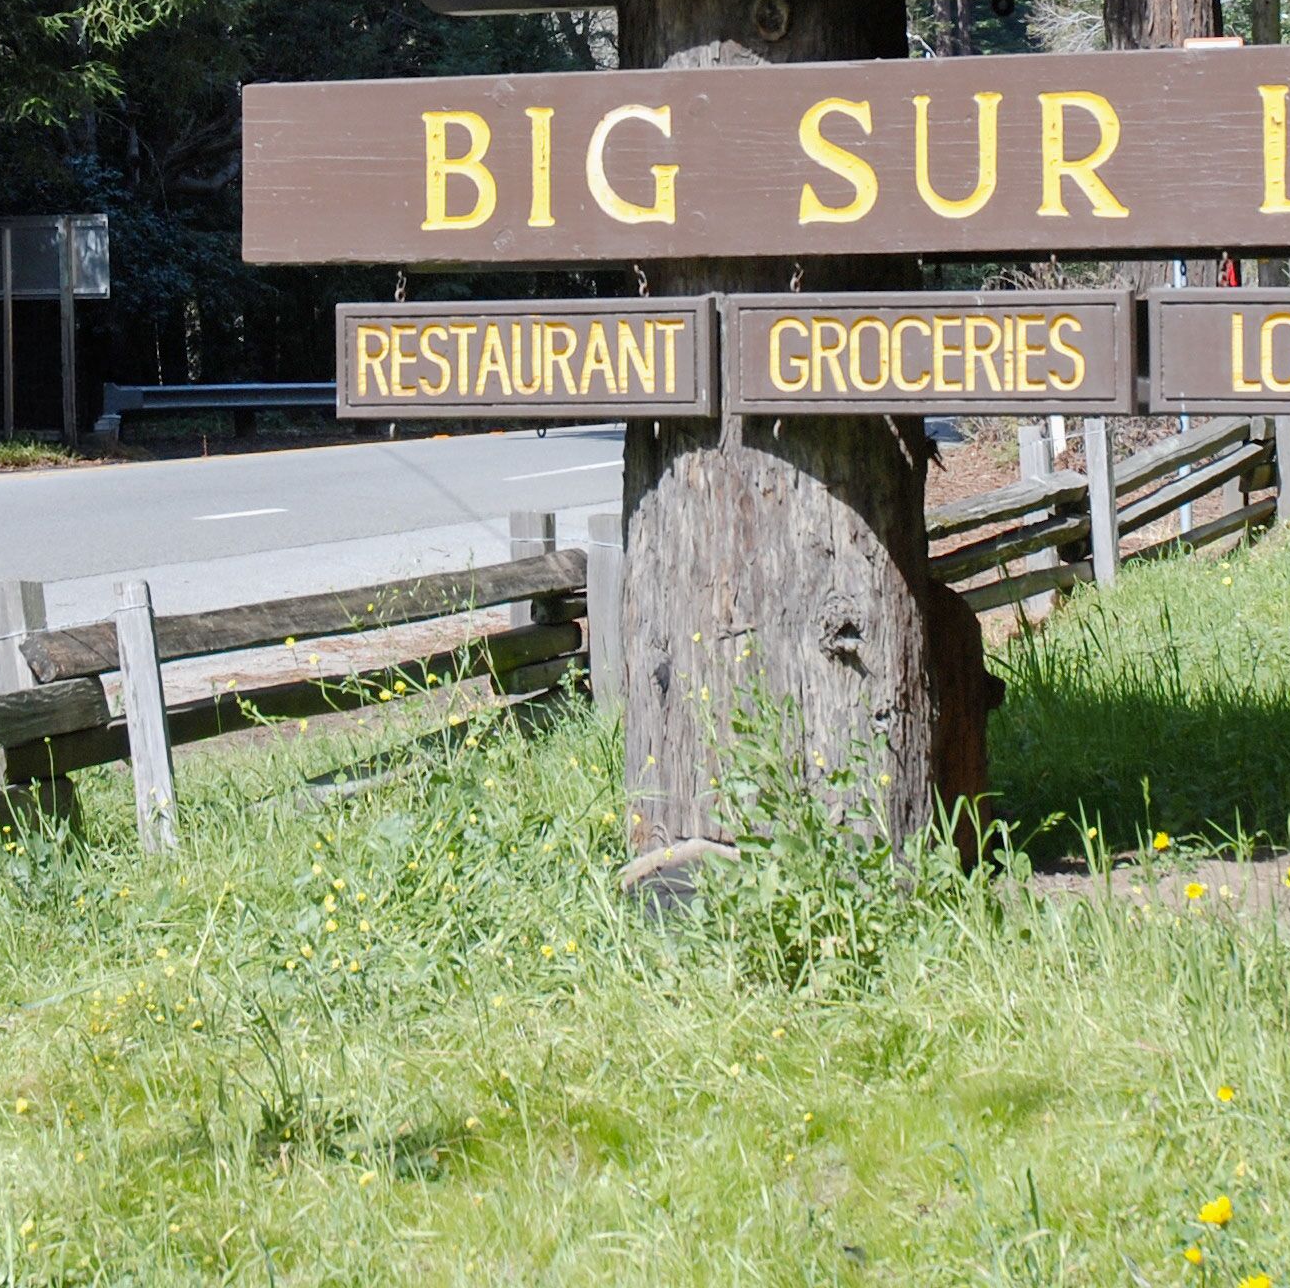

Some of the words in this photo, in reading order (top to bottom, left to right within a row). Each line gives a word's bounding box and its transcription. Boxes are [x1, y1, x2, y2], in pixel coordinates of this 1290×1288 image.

[421, 104, 681, 232] BIG
[798, 90, 1131, 221] SUR
[357, 318, 685, 396] RESTAURANT
[769, 313, 1085, 391] GROCERIES
